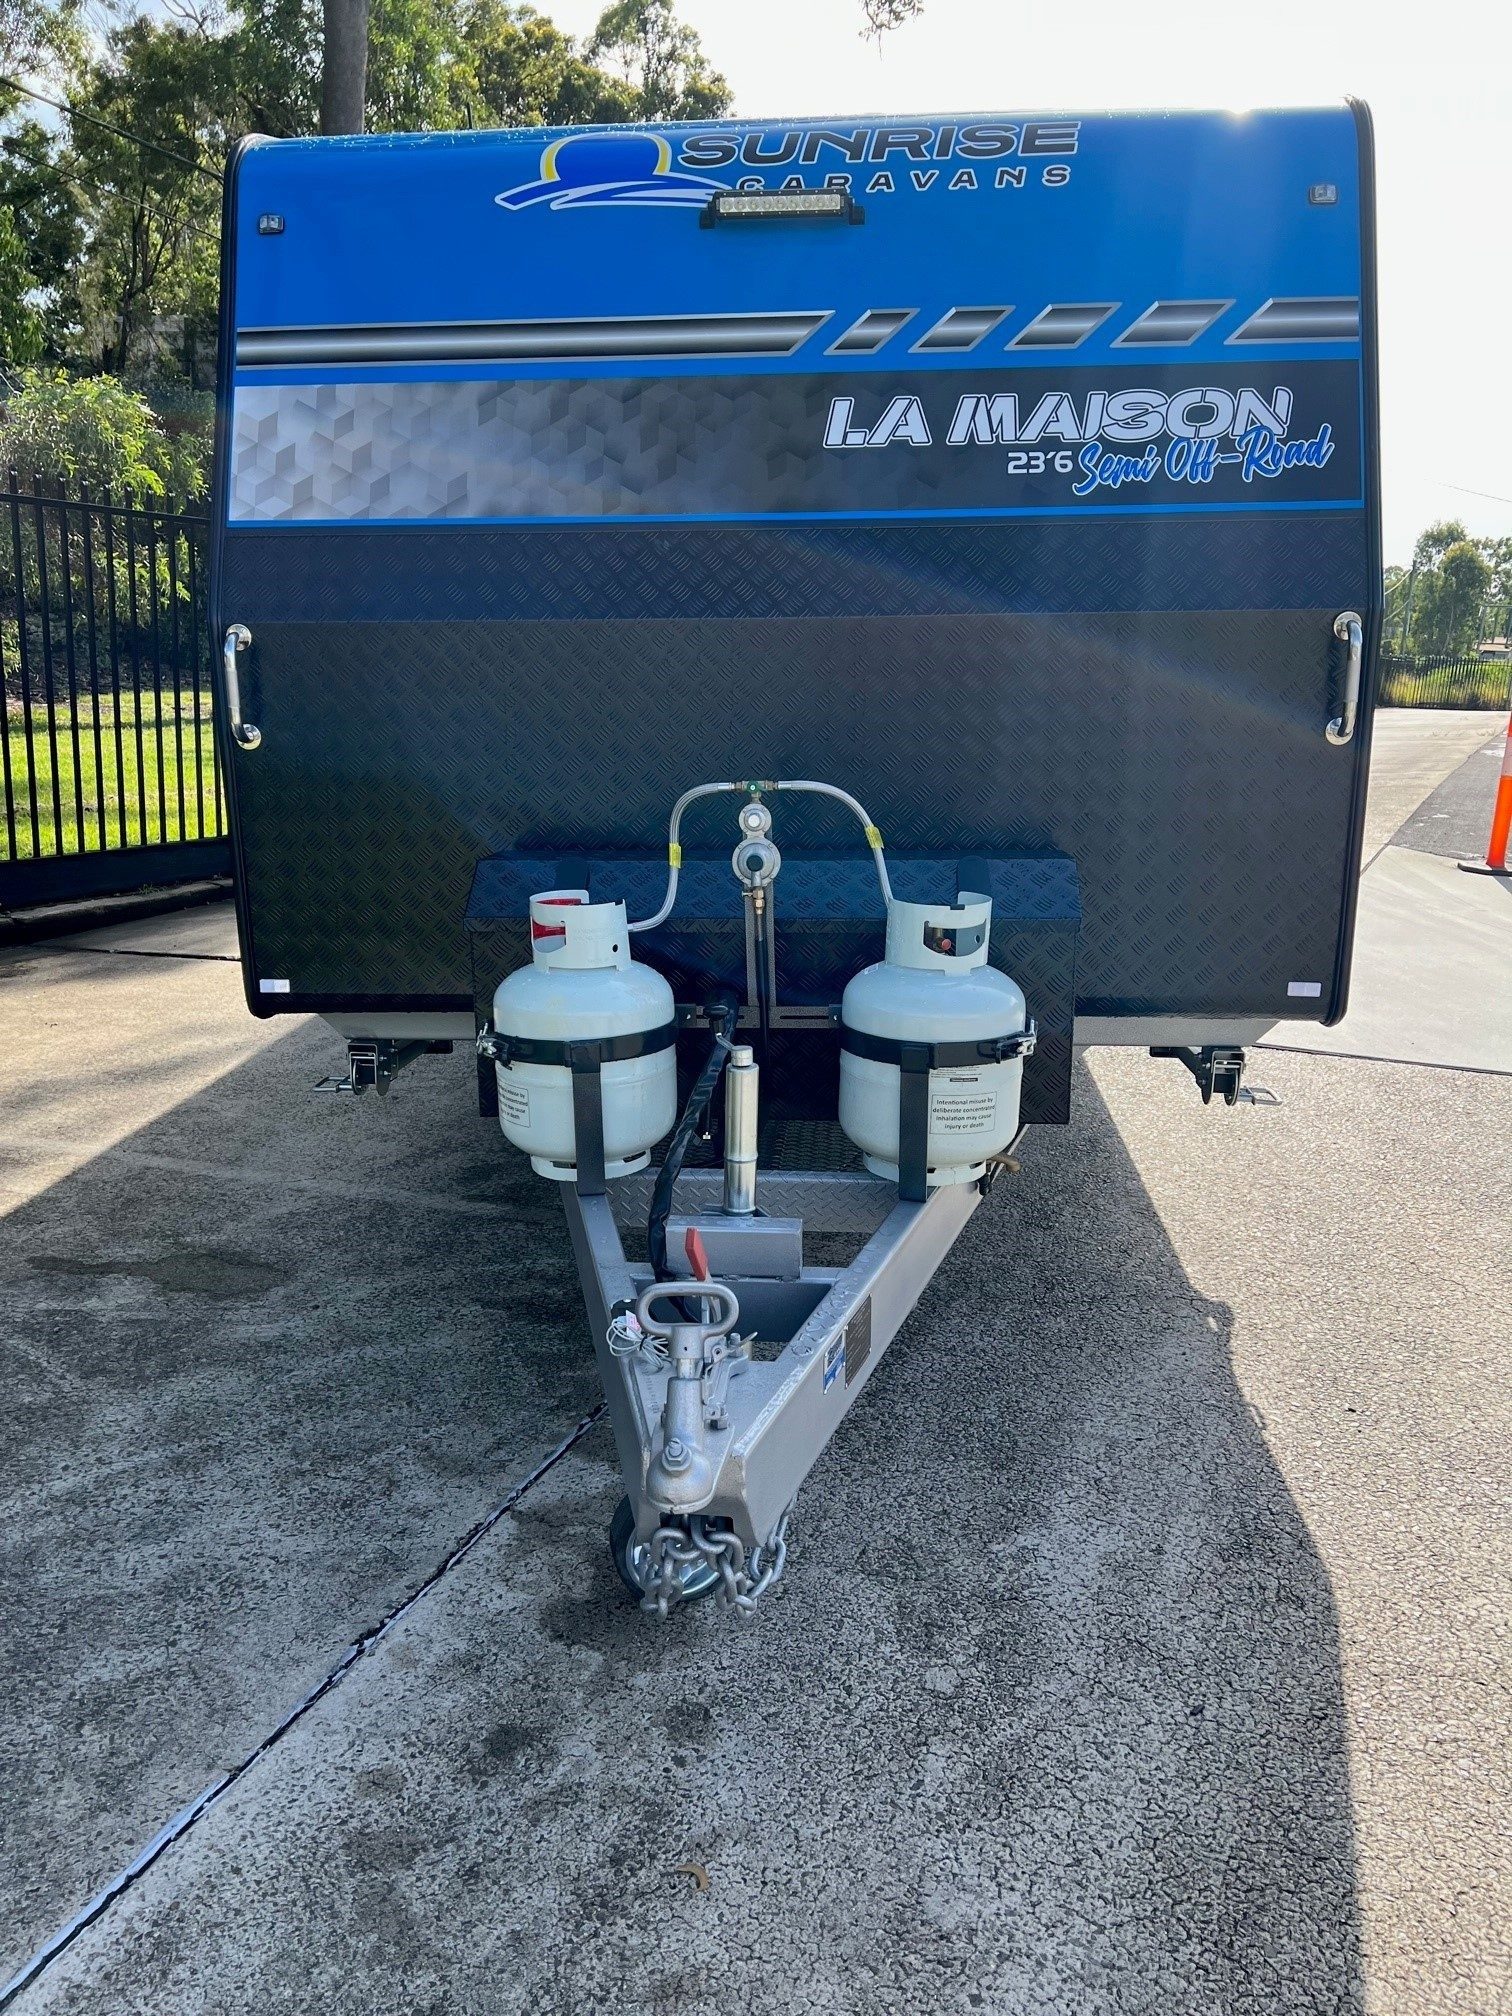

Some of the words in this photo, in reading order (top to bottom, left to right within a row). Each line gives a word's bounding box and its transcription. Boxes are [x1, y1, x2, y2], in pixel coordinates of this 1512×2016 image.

[677, 121, 1082, 169] SUNRISE
[736, 165, 1072, 193] CARAVANS
[823, 396, 932, 448] LA
[946, 387, 1293, 447] MAISON
[1072, 441, 1161, 495] Semi
[1165, 424, 1335, 483] Off-Road
